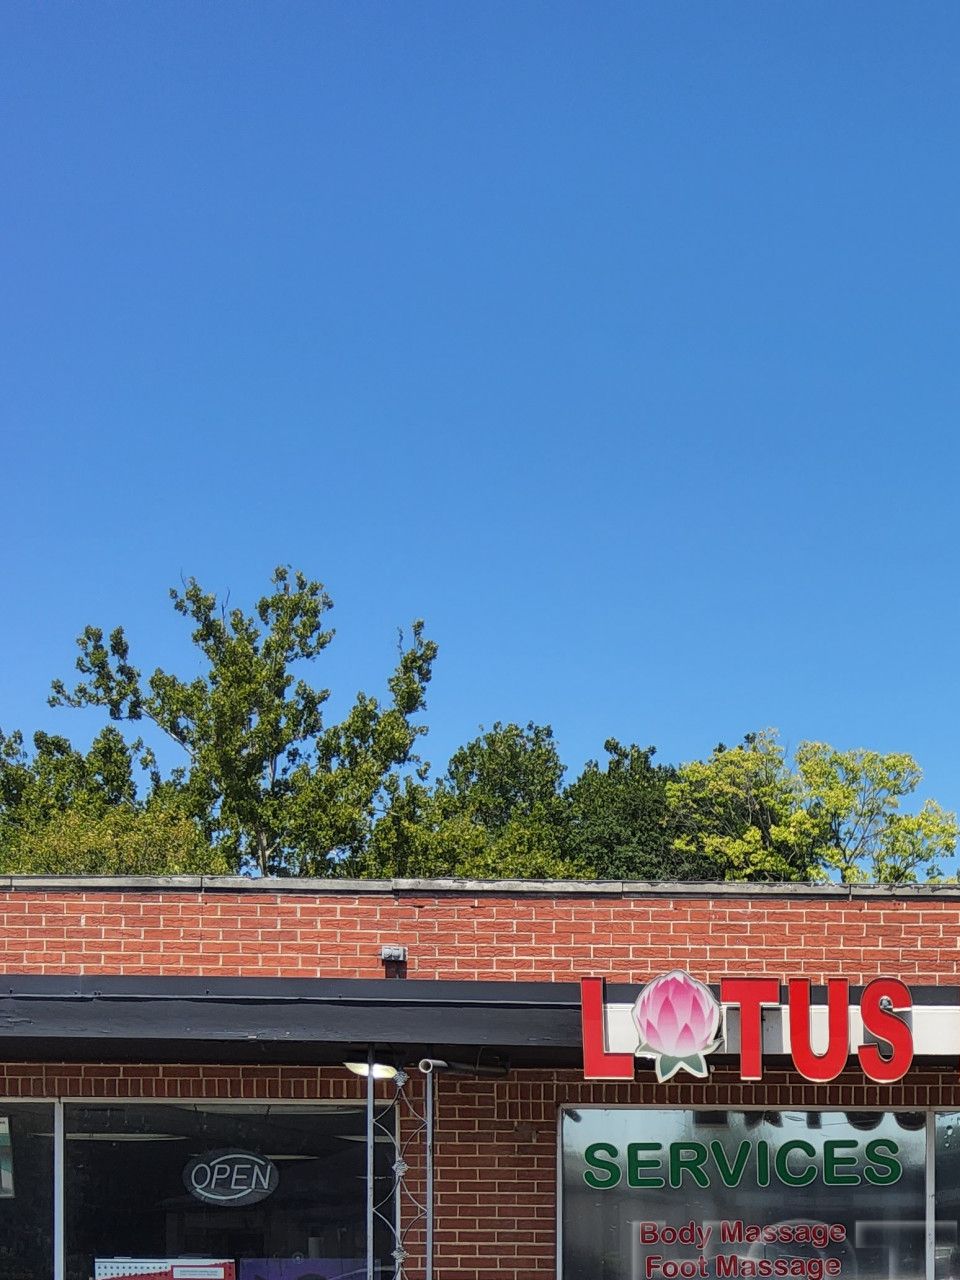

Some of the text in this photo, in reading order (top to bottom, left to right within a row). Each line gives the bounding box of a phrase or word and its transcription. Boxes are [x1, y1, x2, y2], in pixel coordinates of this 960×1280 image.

[580, 969, 915, 1084] LTUS
[191, 1163, 272, 1191] OPEN
[582, 1137, 903, 1189] SERVICES
[639, 1219, 847, 1249] Body Massage
[645, 1254, 842, 1280] Foot Massage
